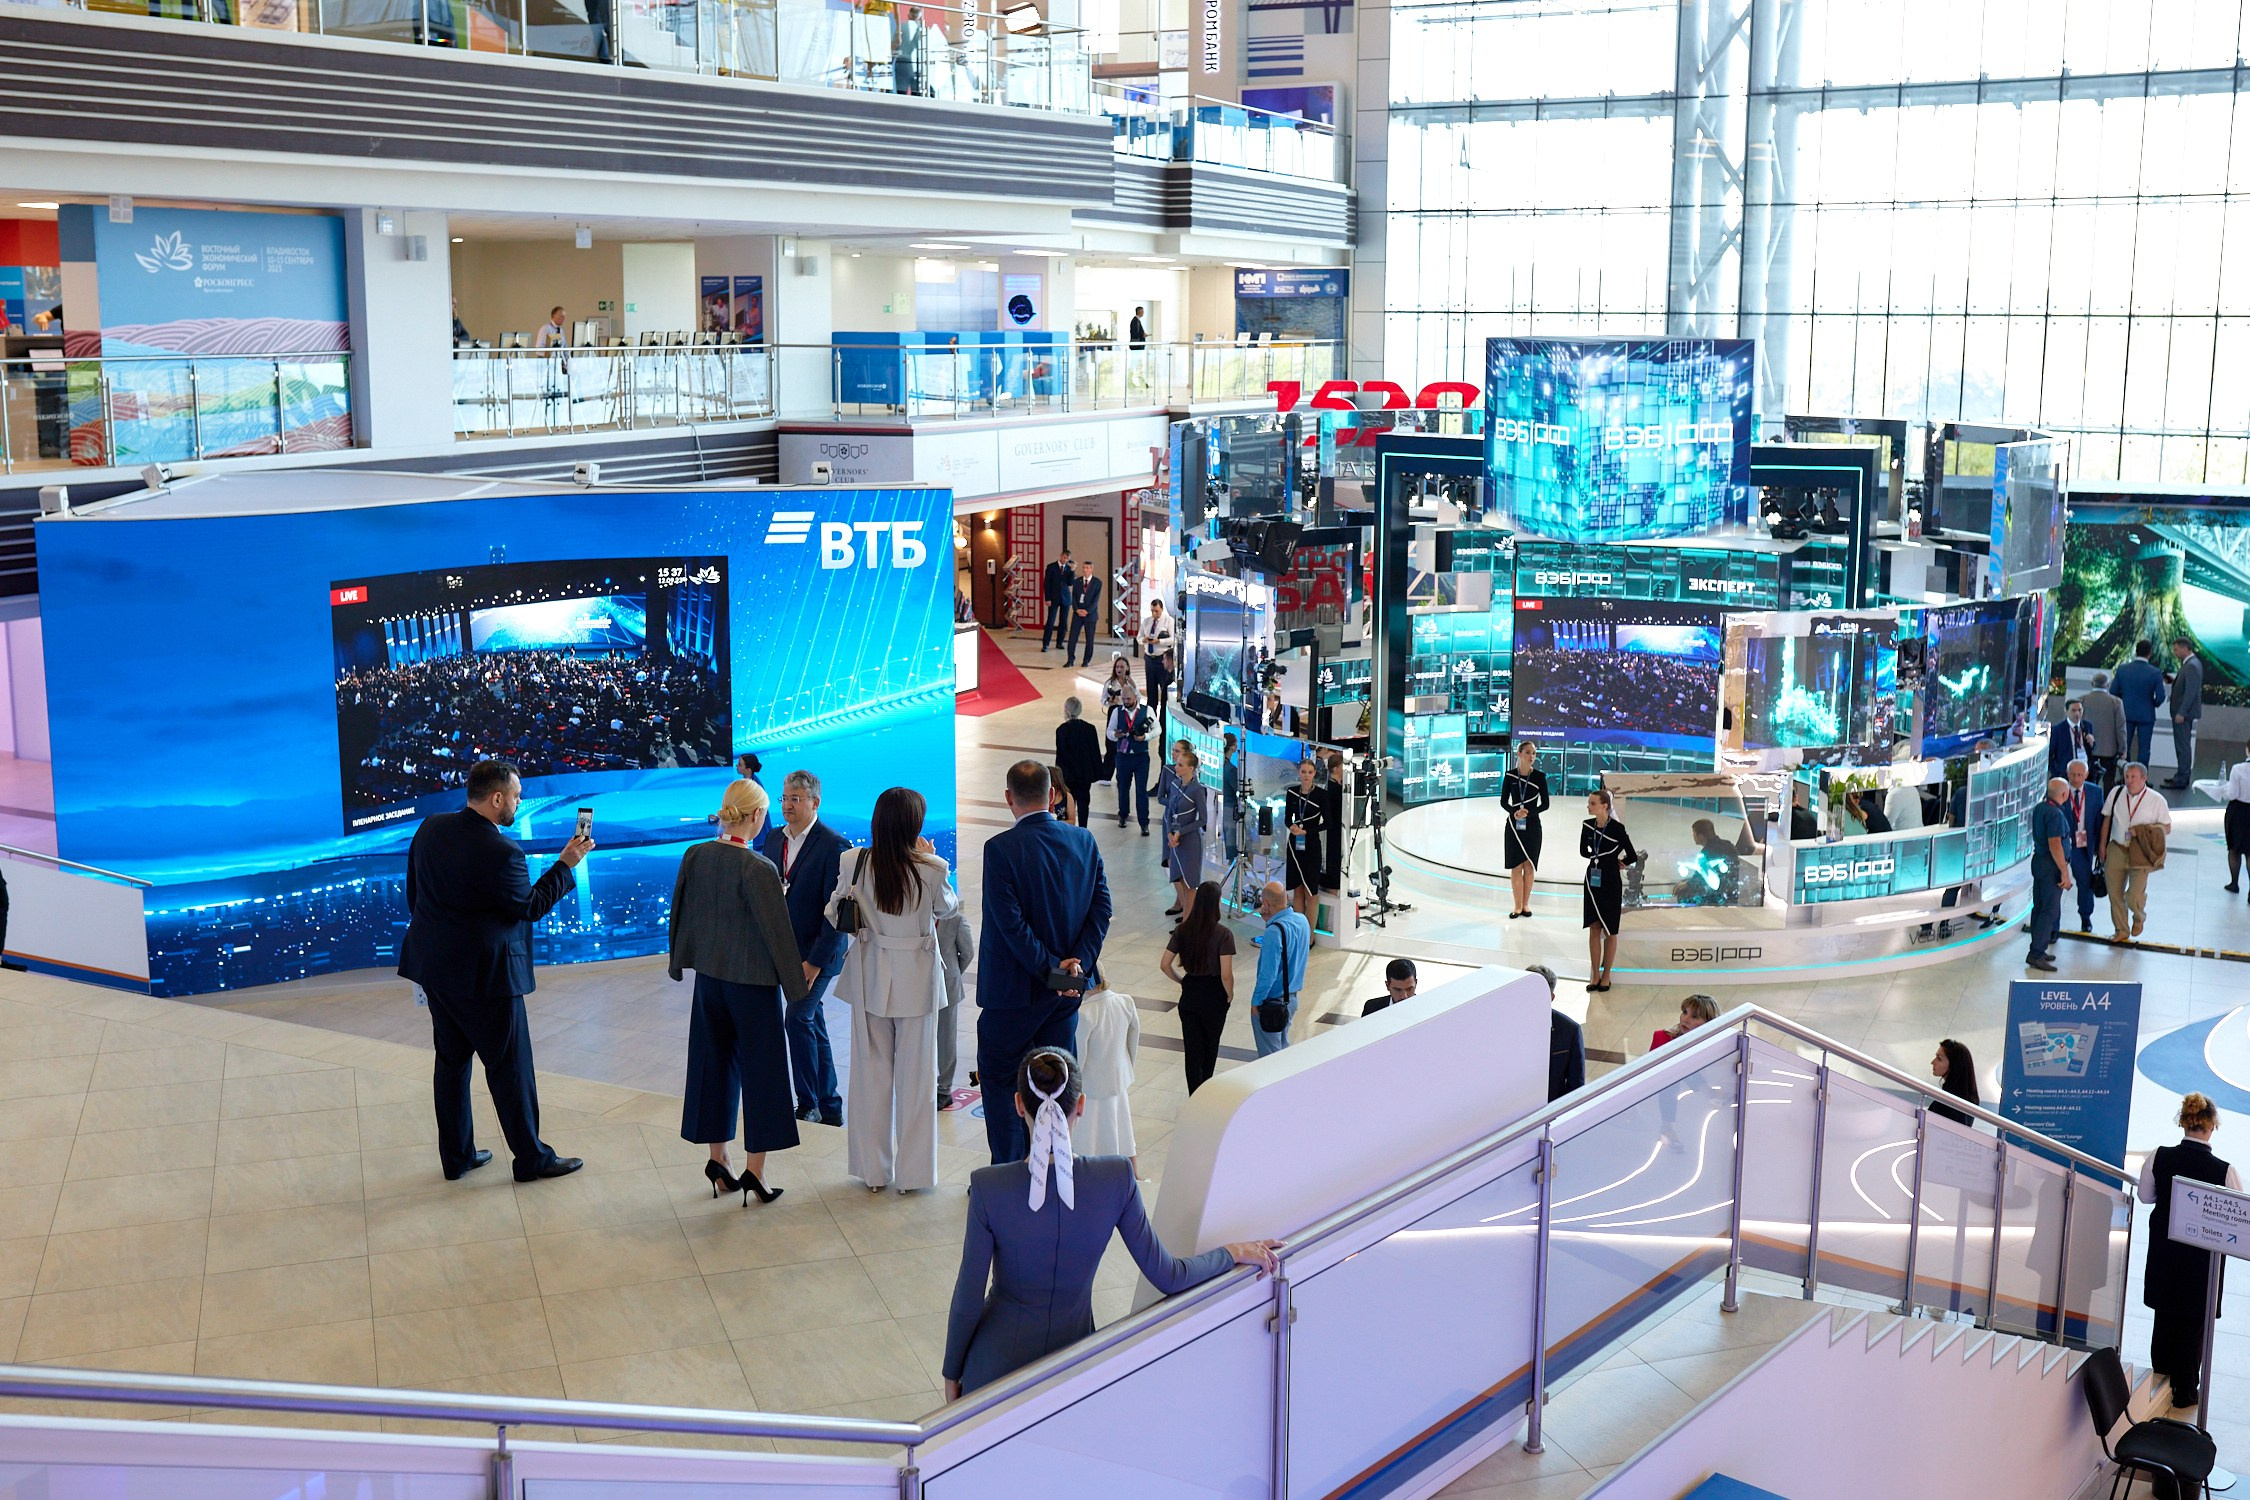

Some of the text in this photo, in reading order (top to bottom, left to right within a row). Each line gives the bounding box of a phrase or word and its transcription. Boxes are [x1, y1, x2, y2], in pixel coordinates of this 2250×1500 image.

[201, 244, 240, 254] ВОСТОЧНЫЙ
[266, 246, 310, 256] ВЛАДИВОСТОК
[201, 254, 258, 263] ЭКОНОМИЧЕСКИЙ
[202, 263, 226, 272] ФОРУМ
[203, 278, 255, 287] РОСКОНГРЕСС
[1074, 437, 1095, 451] CLUB
[834, 476, 855, 484] CLUB
[821, 520, 927, 570] ВТБ
[1688, 577, 1755, 593] ЭКСПЕРТ
[340, 590, 358, 602] LIVE
[352, 807, 416, 827] ПЛЕНАРНОЕ ЗАСЕДАНИЕ
[2040, 991, 2072, 1001] LEVEL
[2081, 991, 2112, 1011] A4
[2040, 1002, 2078, 1010] УРОВЕНЬ
[2202, 1208, 2230, 1221] Meeting
[2202, 1226, 2223, 1238] Toilets
